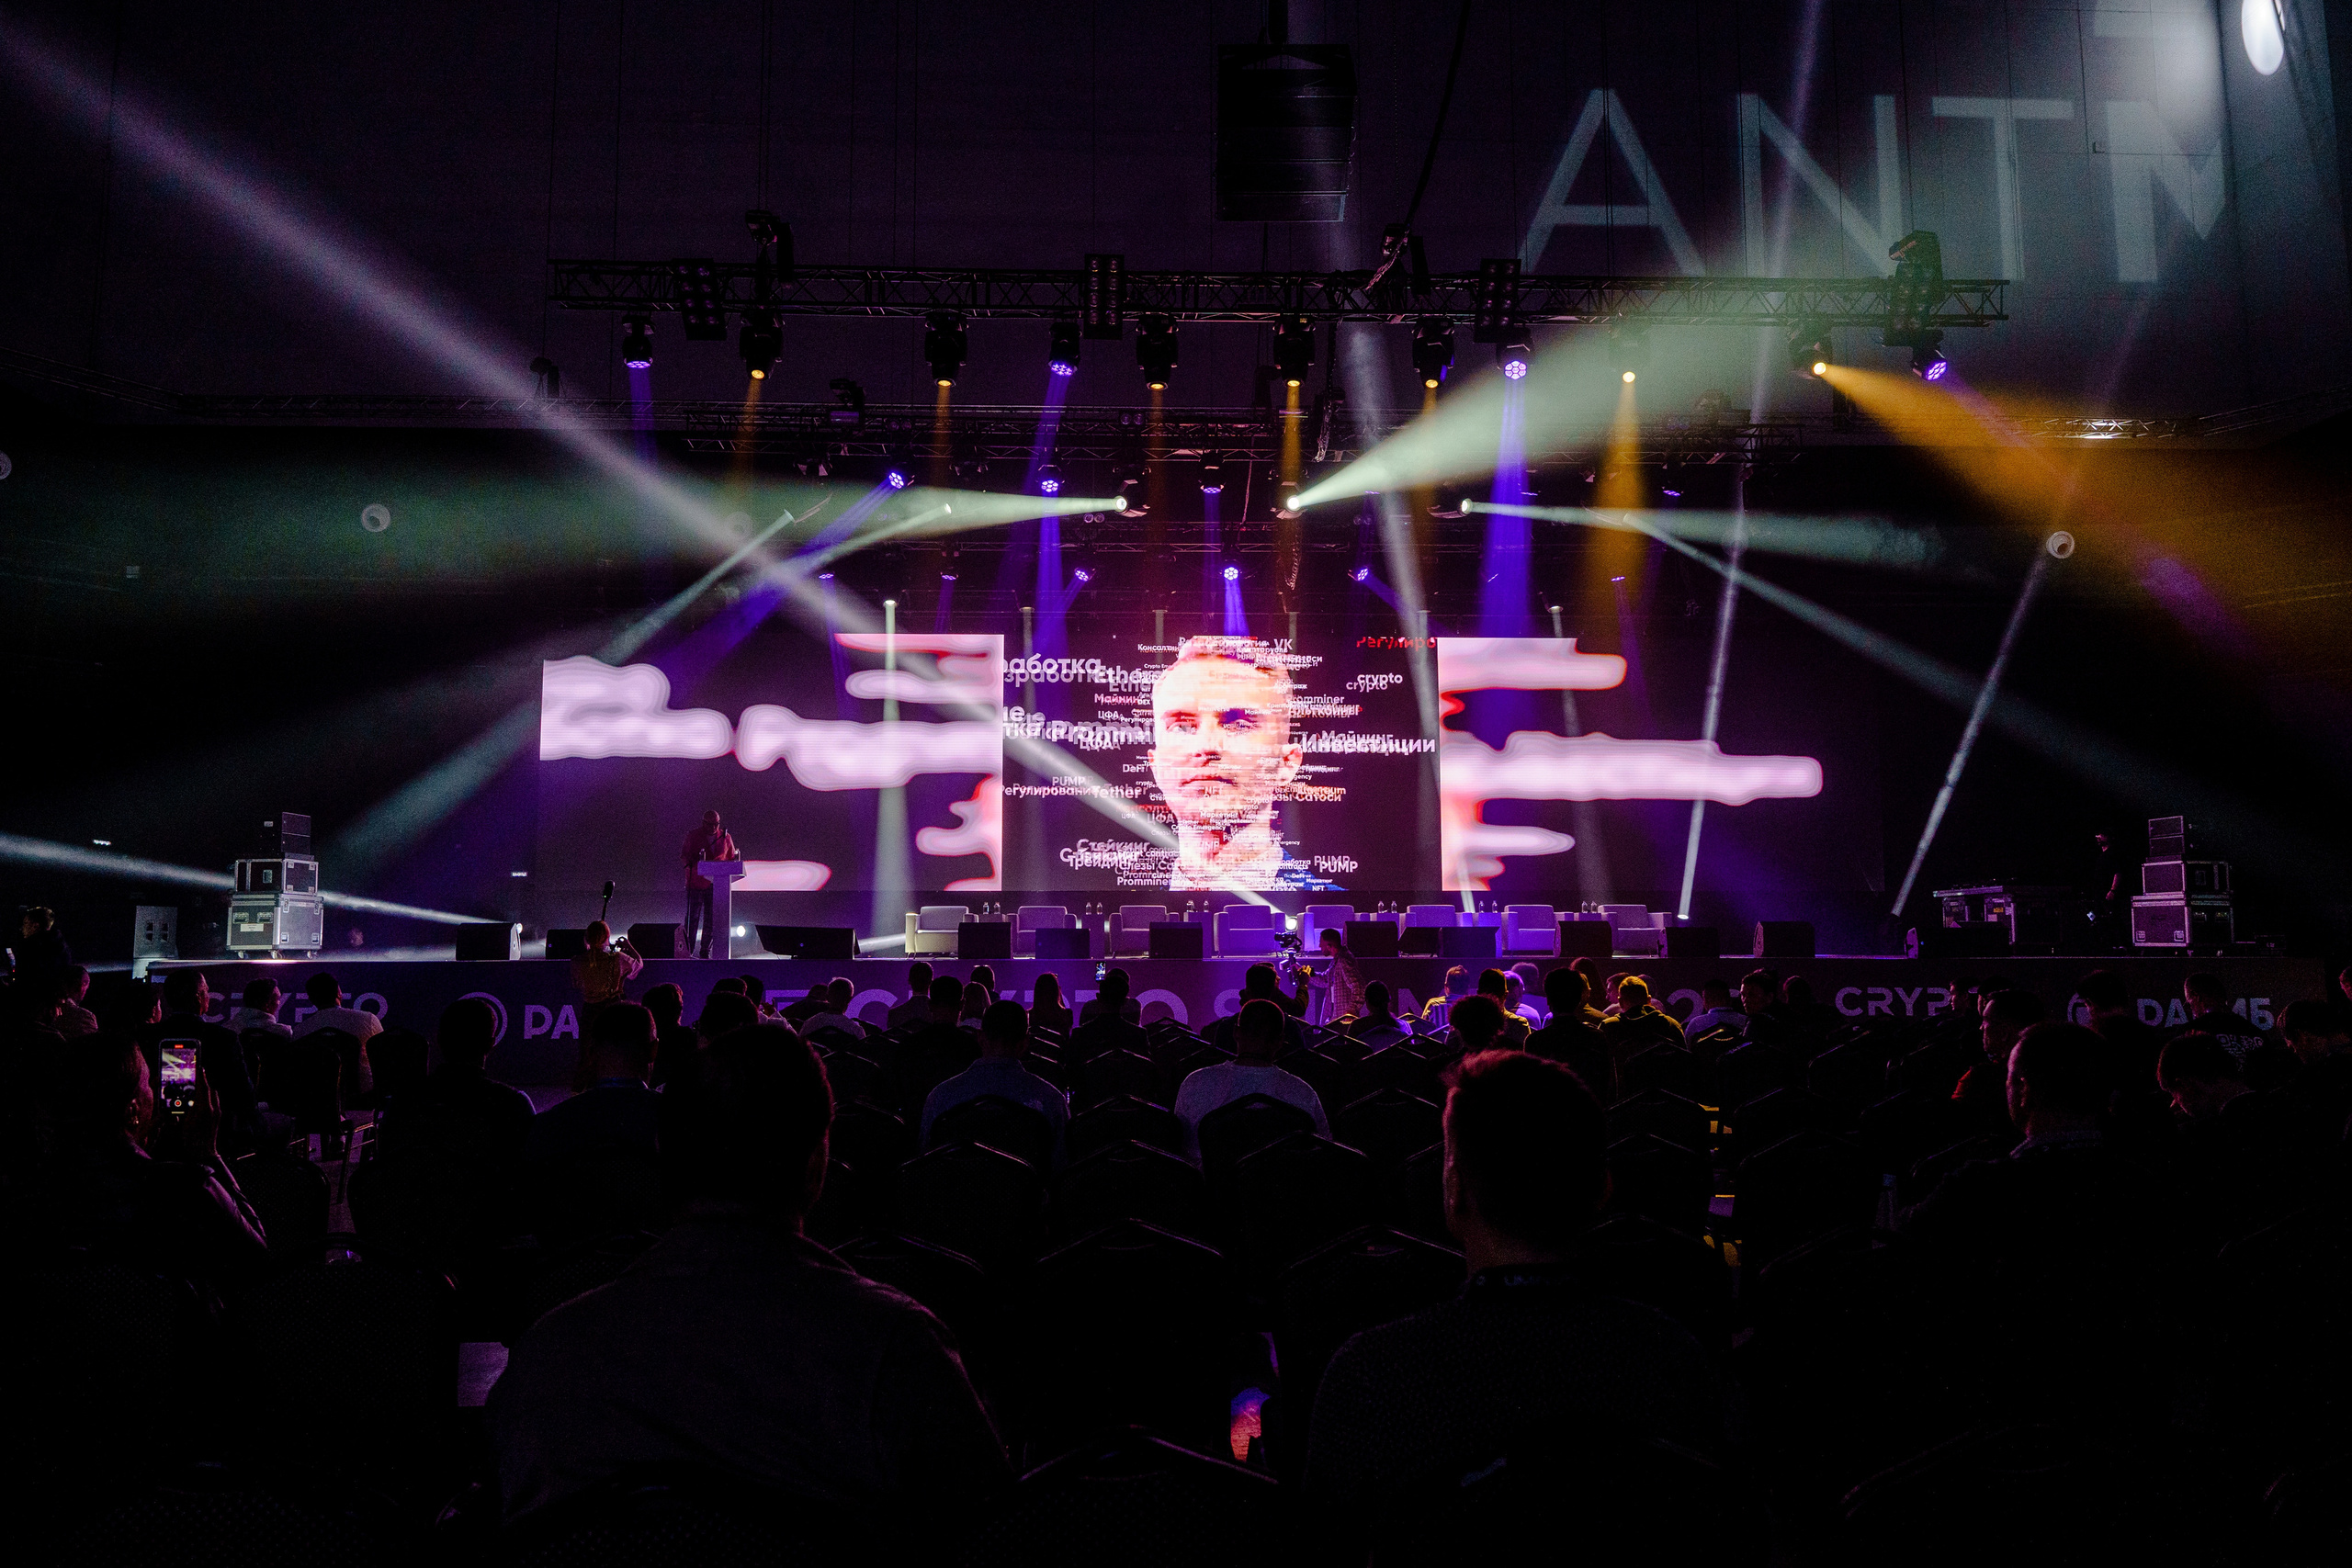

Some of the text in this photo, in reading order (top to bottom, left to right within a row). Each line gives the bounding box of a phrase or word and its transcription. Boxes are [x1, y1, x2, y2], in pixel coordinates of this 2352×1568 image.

[1273, 638, 1294, 650] VK
[1346, 679, 1388, 693] crypto
[1357, 672, 1404, 688] crypto
[1092, 784, 1140, 799] Tether
[1077, 838, 1151, 852] Стейкинг
[1319, 861, 1359, 873] PUMP
